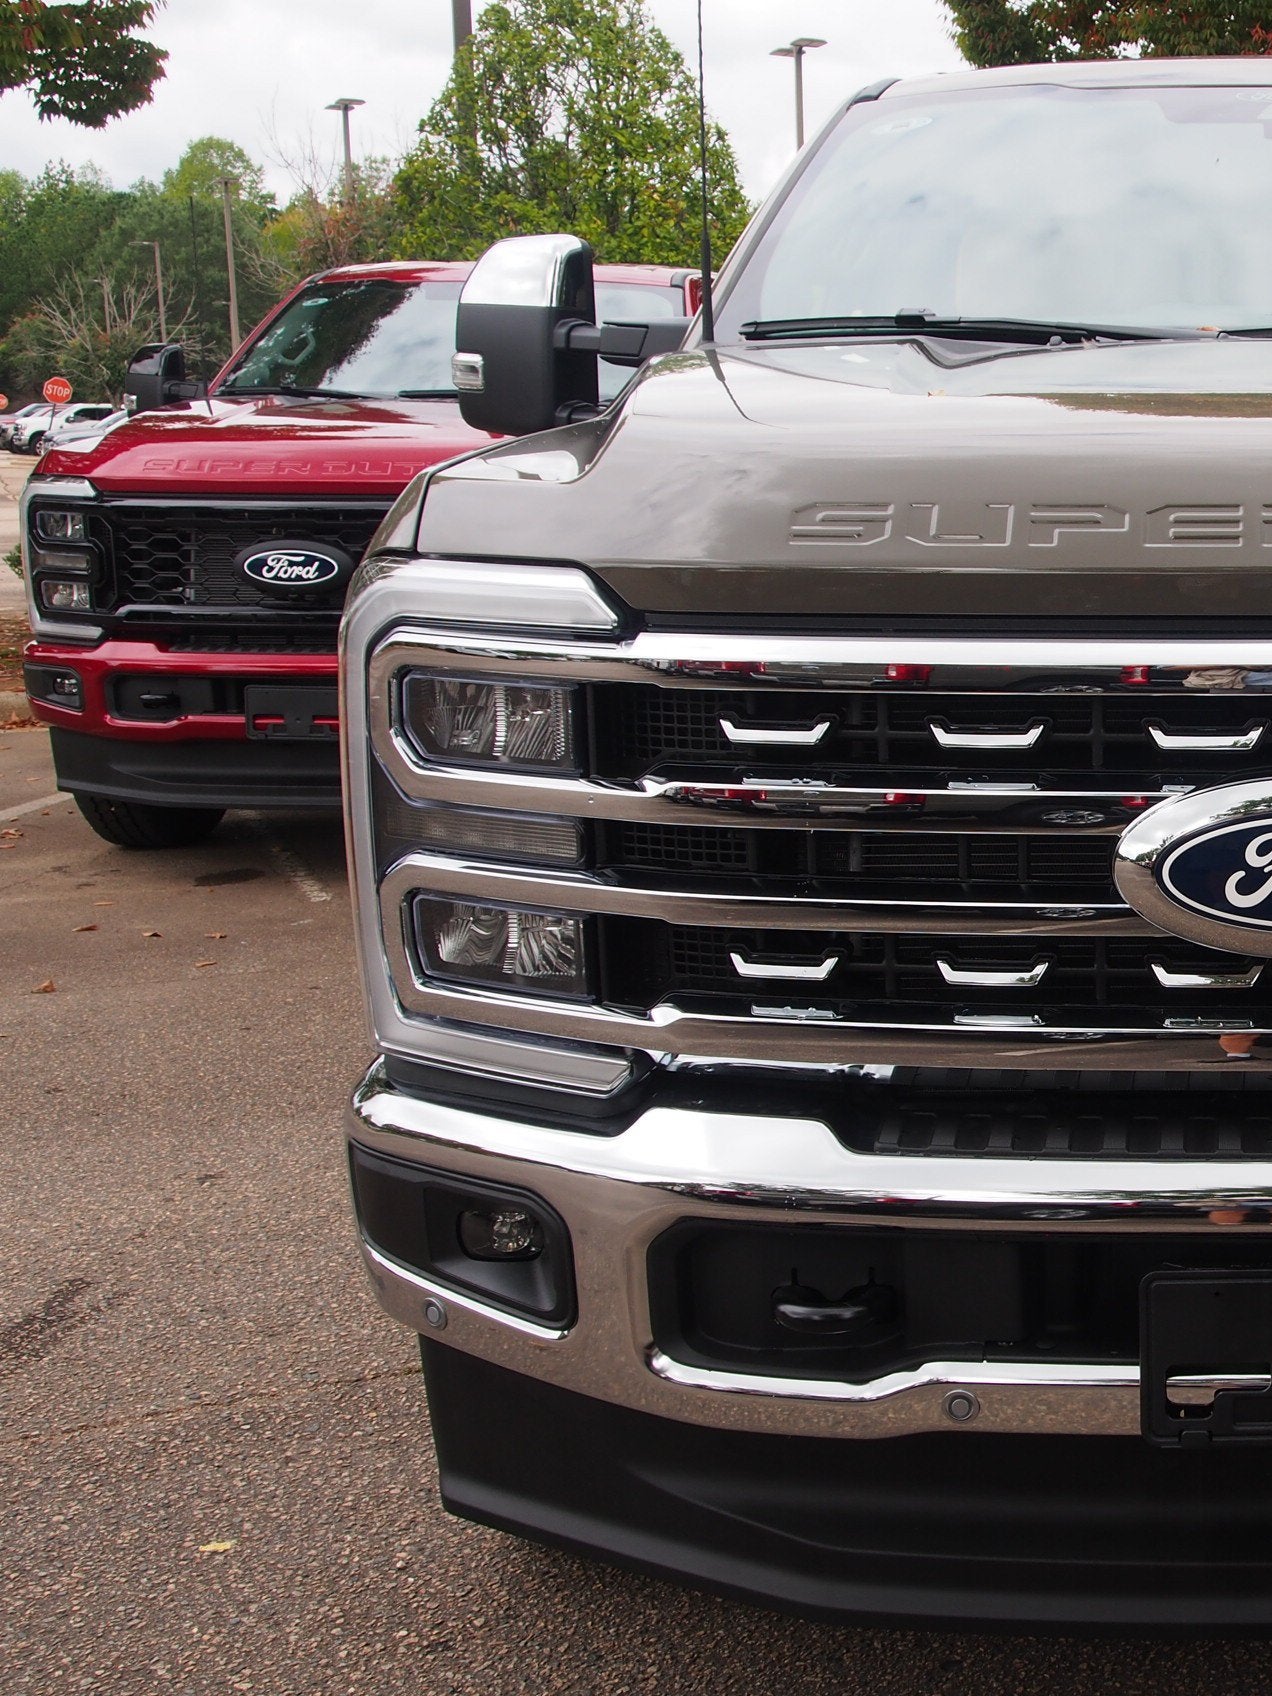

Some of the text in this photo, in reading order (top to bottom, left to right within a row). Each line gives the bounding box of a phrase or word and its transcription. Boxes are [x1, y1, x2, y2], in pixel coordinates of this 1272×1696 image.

[46, 384, 71, 398] STOP
[142, 458, 436, 476] SUPER DUT
[261, 554, 320, 579] Ford
